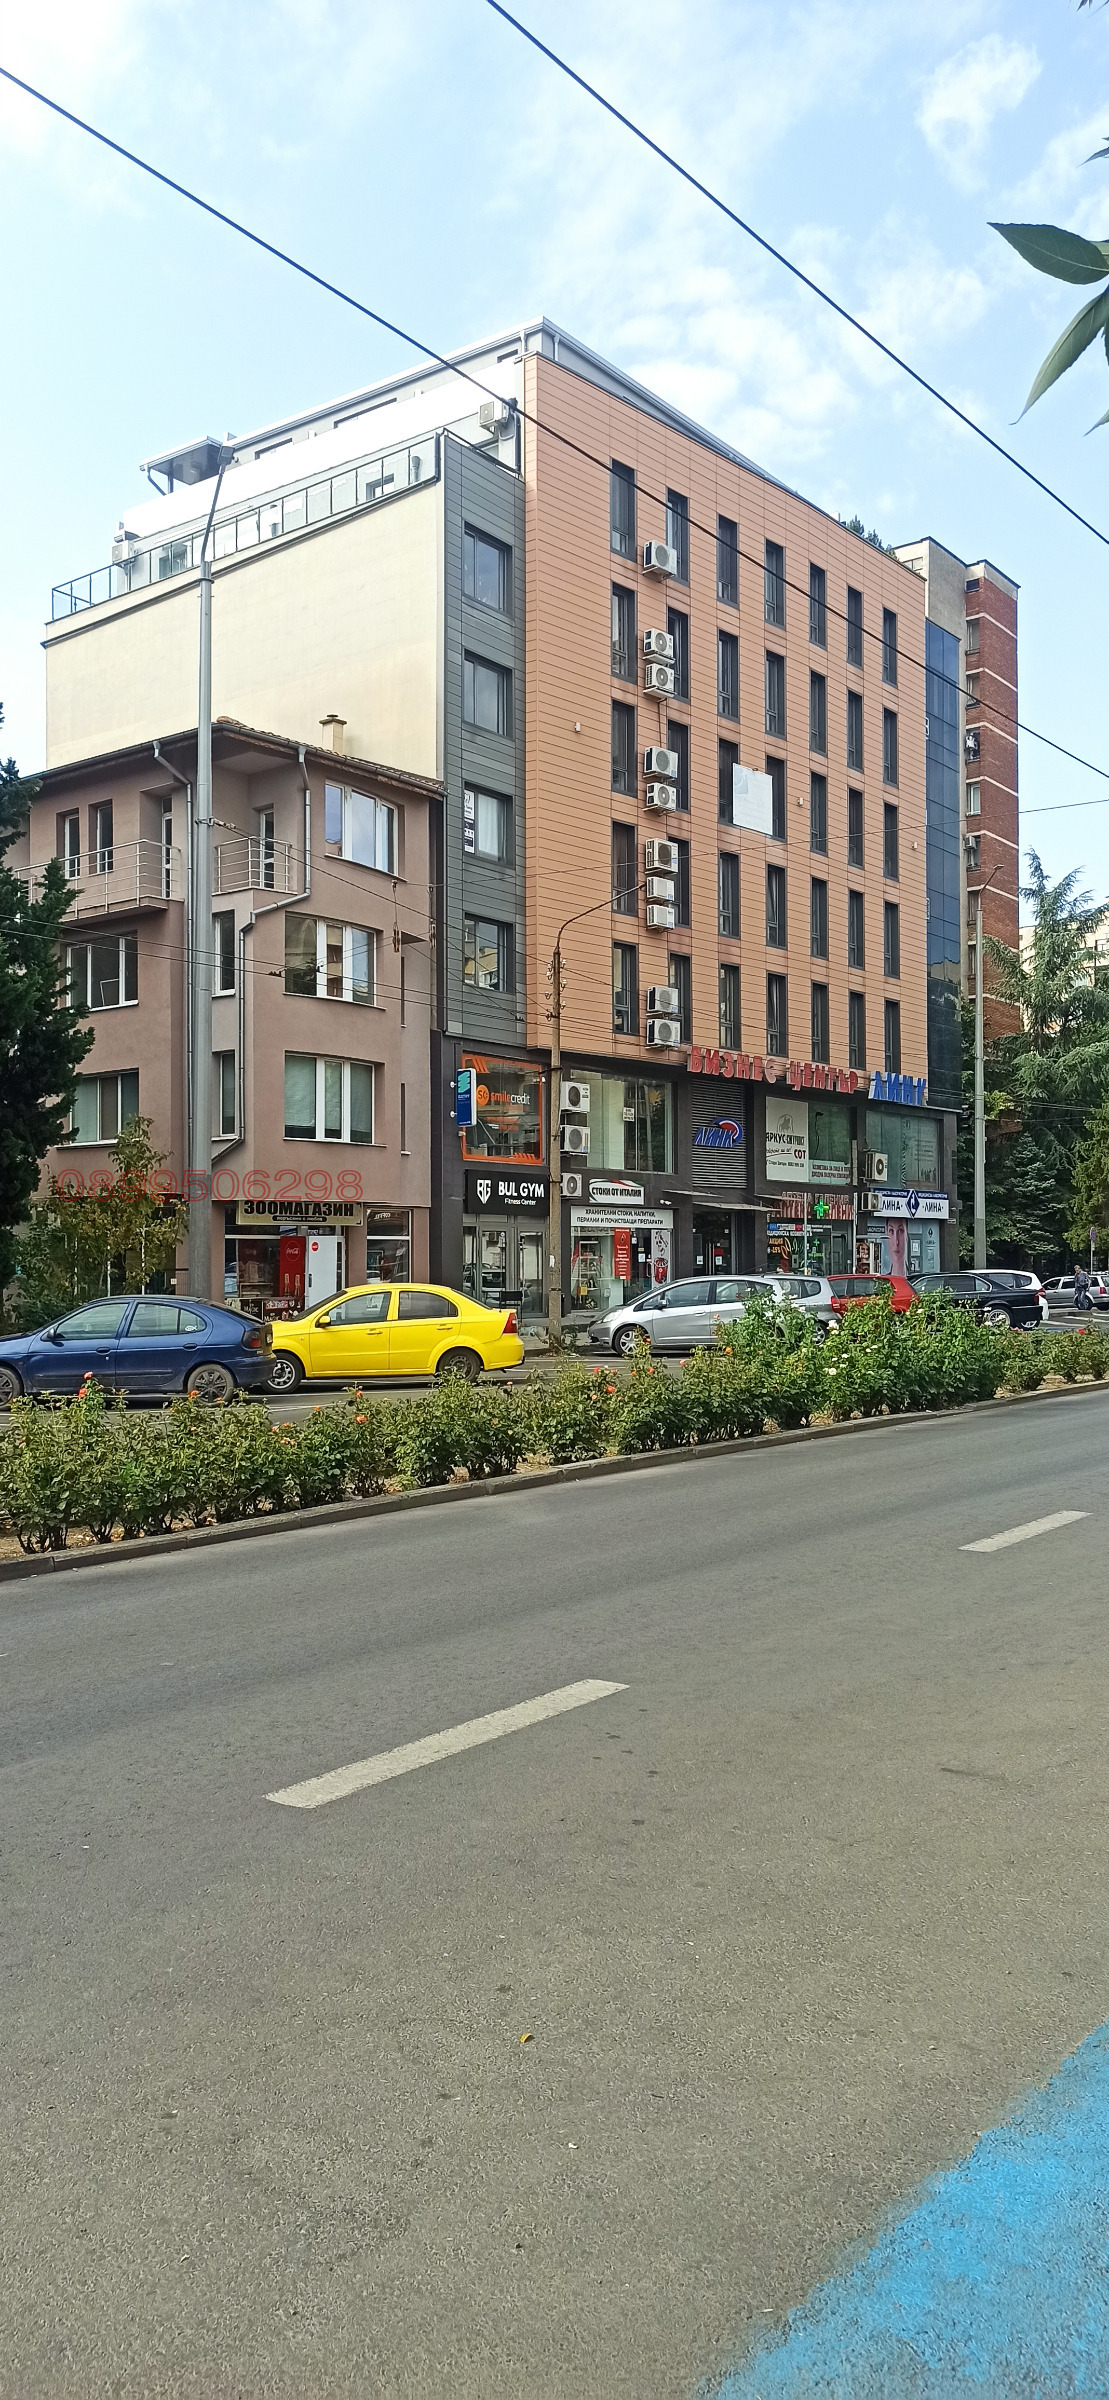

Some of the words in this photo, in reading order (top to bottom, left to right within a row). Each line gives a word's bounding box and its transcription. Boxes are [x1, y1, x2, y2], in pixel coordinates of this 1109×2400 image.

[687, 1046, 777, 1083] БИЗНЕС
[786, 1060, 859, 1094] ЦЕНТЪР
[868, 1071, 927, 1106] ЛИНК
[693, 1127, 736, 1147] ЛИНК
[498, 1181, 518, 1196] BUL
[520, 1182, 545, 1198] GYM
[592, 1187, 611, 1196] СТОКИ
[611, 1187, 620, 1197] ОТ
[620, 1188, 641, 1197] ИТАЛИЯ
[244, 1201, 354, 1216] ЗООМАГАЗИН
[617, 1209, 634, 1217] СТОКИ,
[604, 1217, 637, 1225] ПОЧИСТВАЩИ
